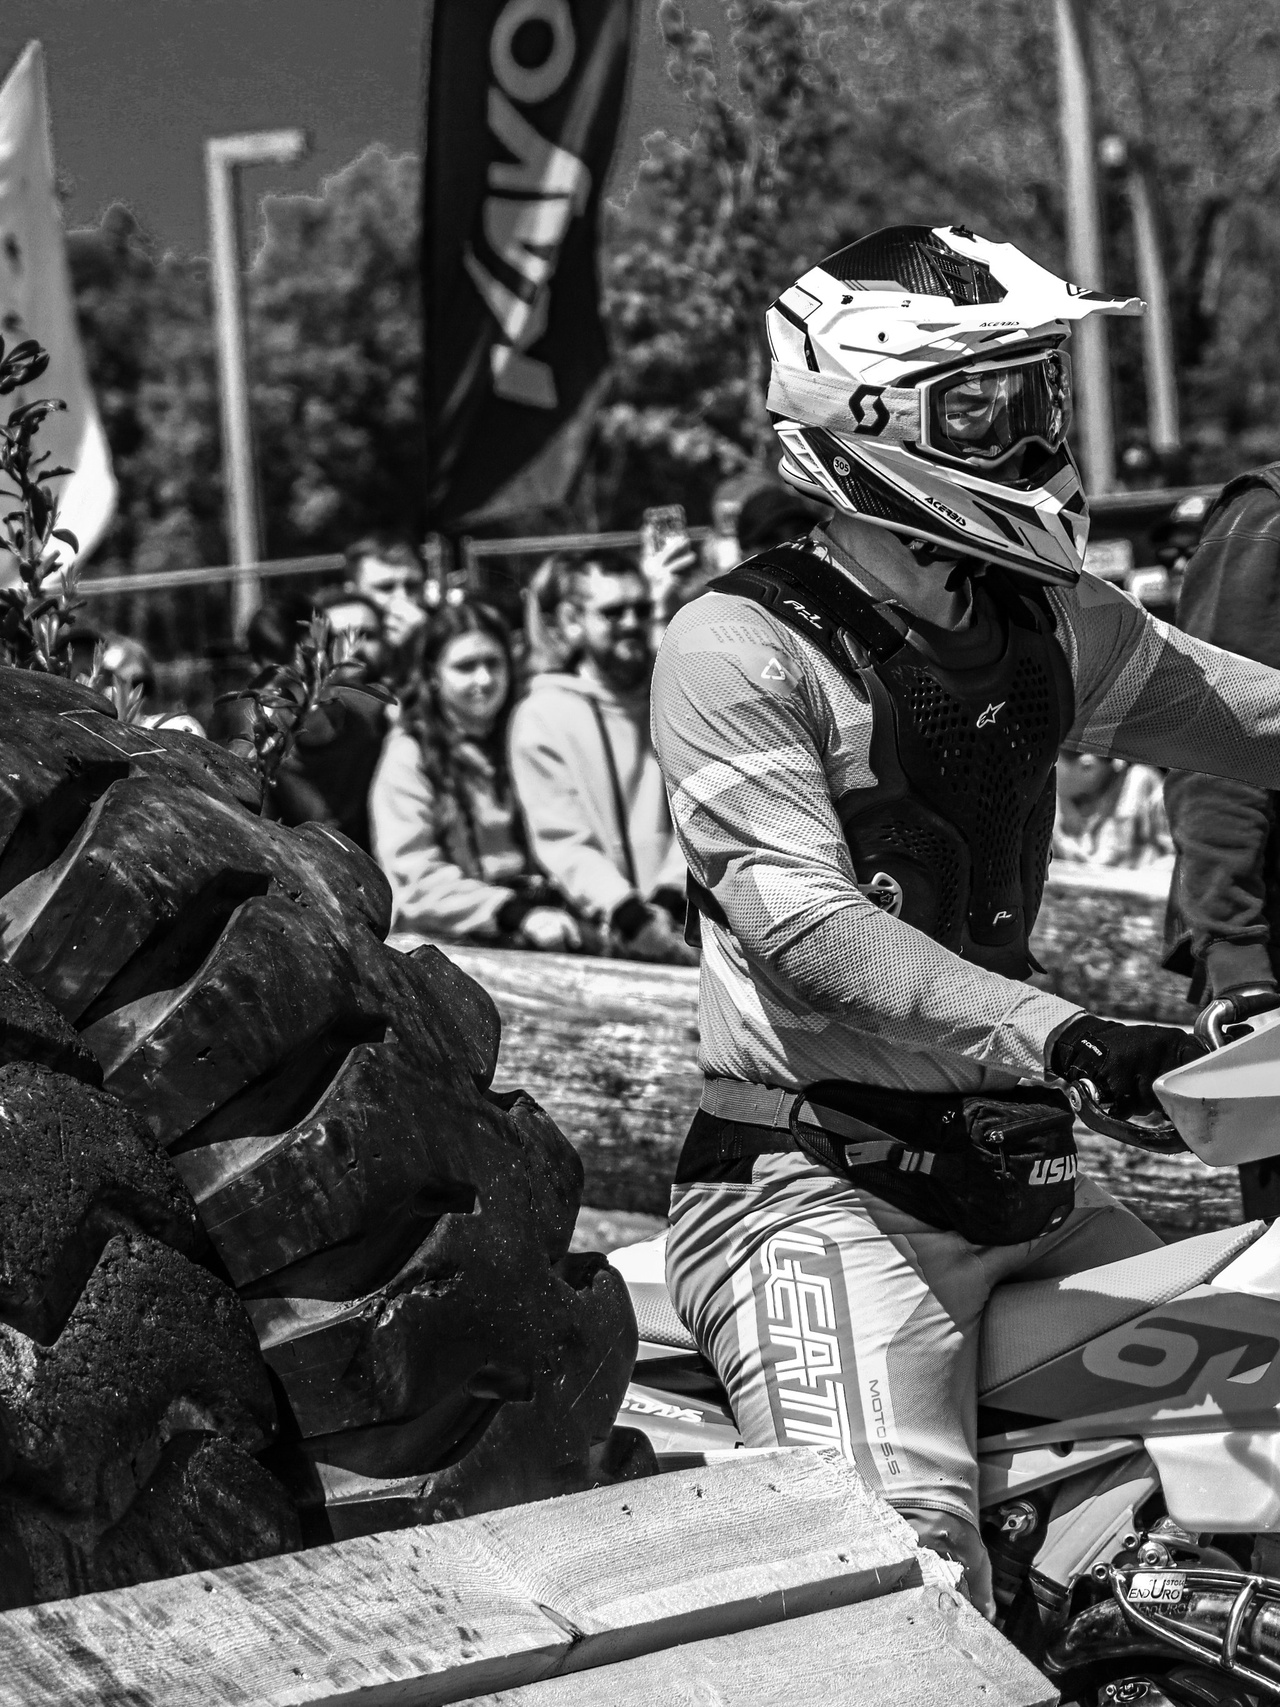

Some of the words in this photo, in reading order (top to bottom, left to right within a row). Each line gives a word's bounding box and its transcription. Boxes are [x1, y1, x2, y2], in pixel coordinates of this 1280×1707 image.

[833, 459, 850, 473] 305
[925, 496, 967, 527] ACERBIS
[868, 1379, 887, 1439] MOTO
[880, 1442, 901, 1477] 5.5
[1128, 1578, 1181, 1600] ENDURO
